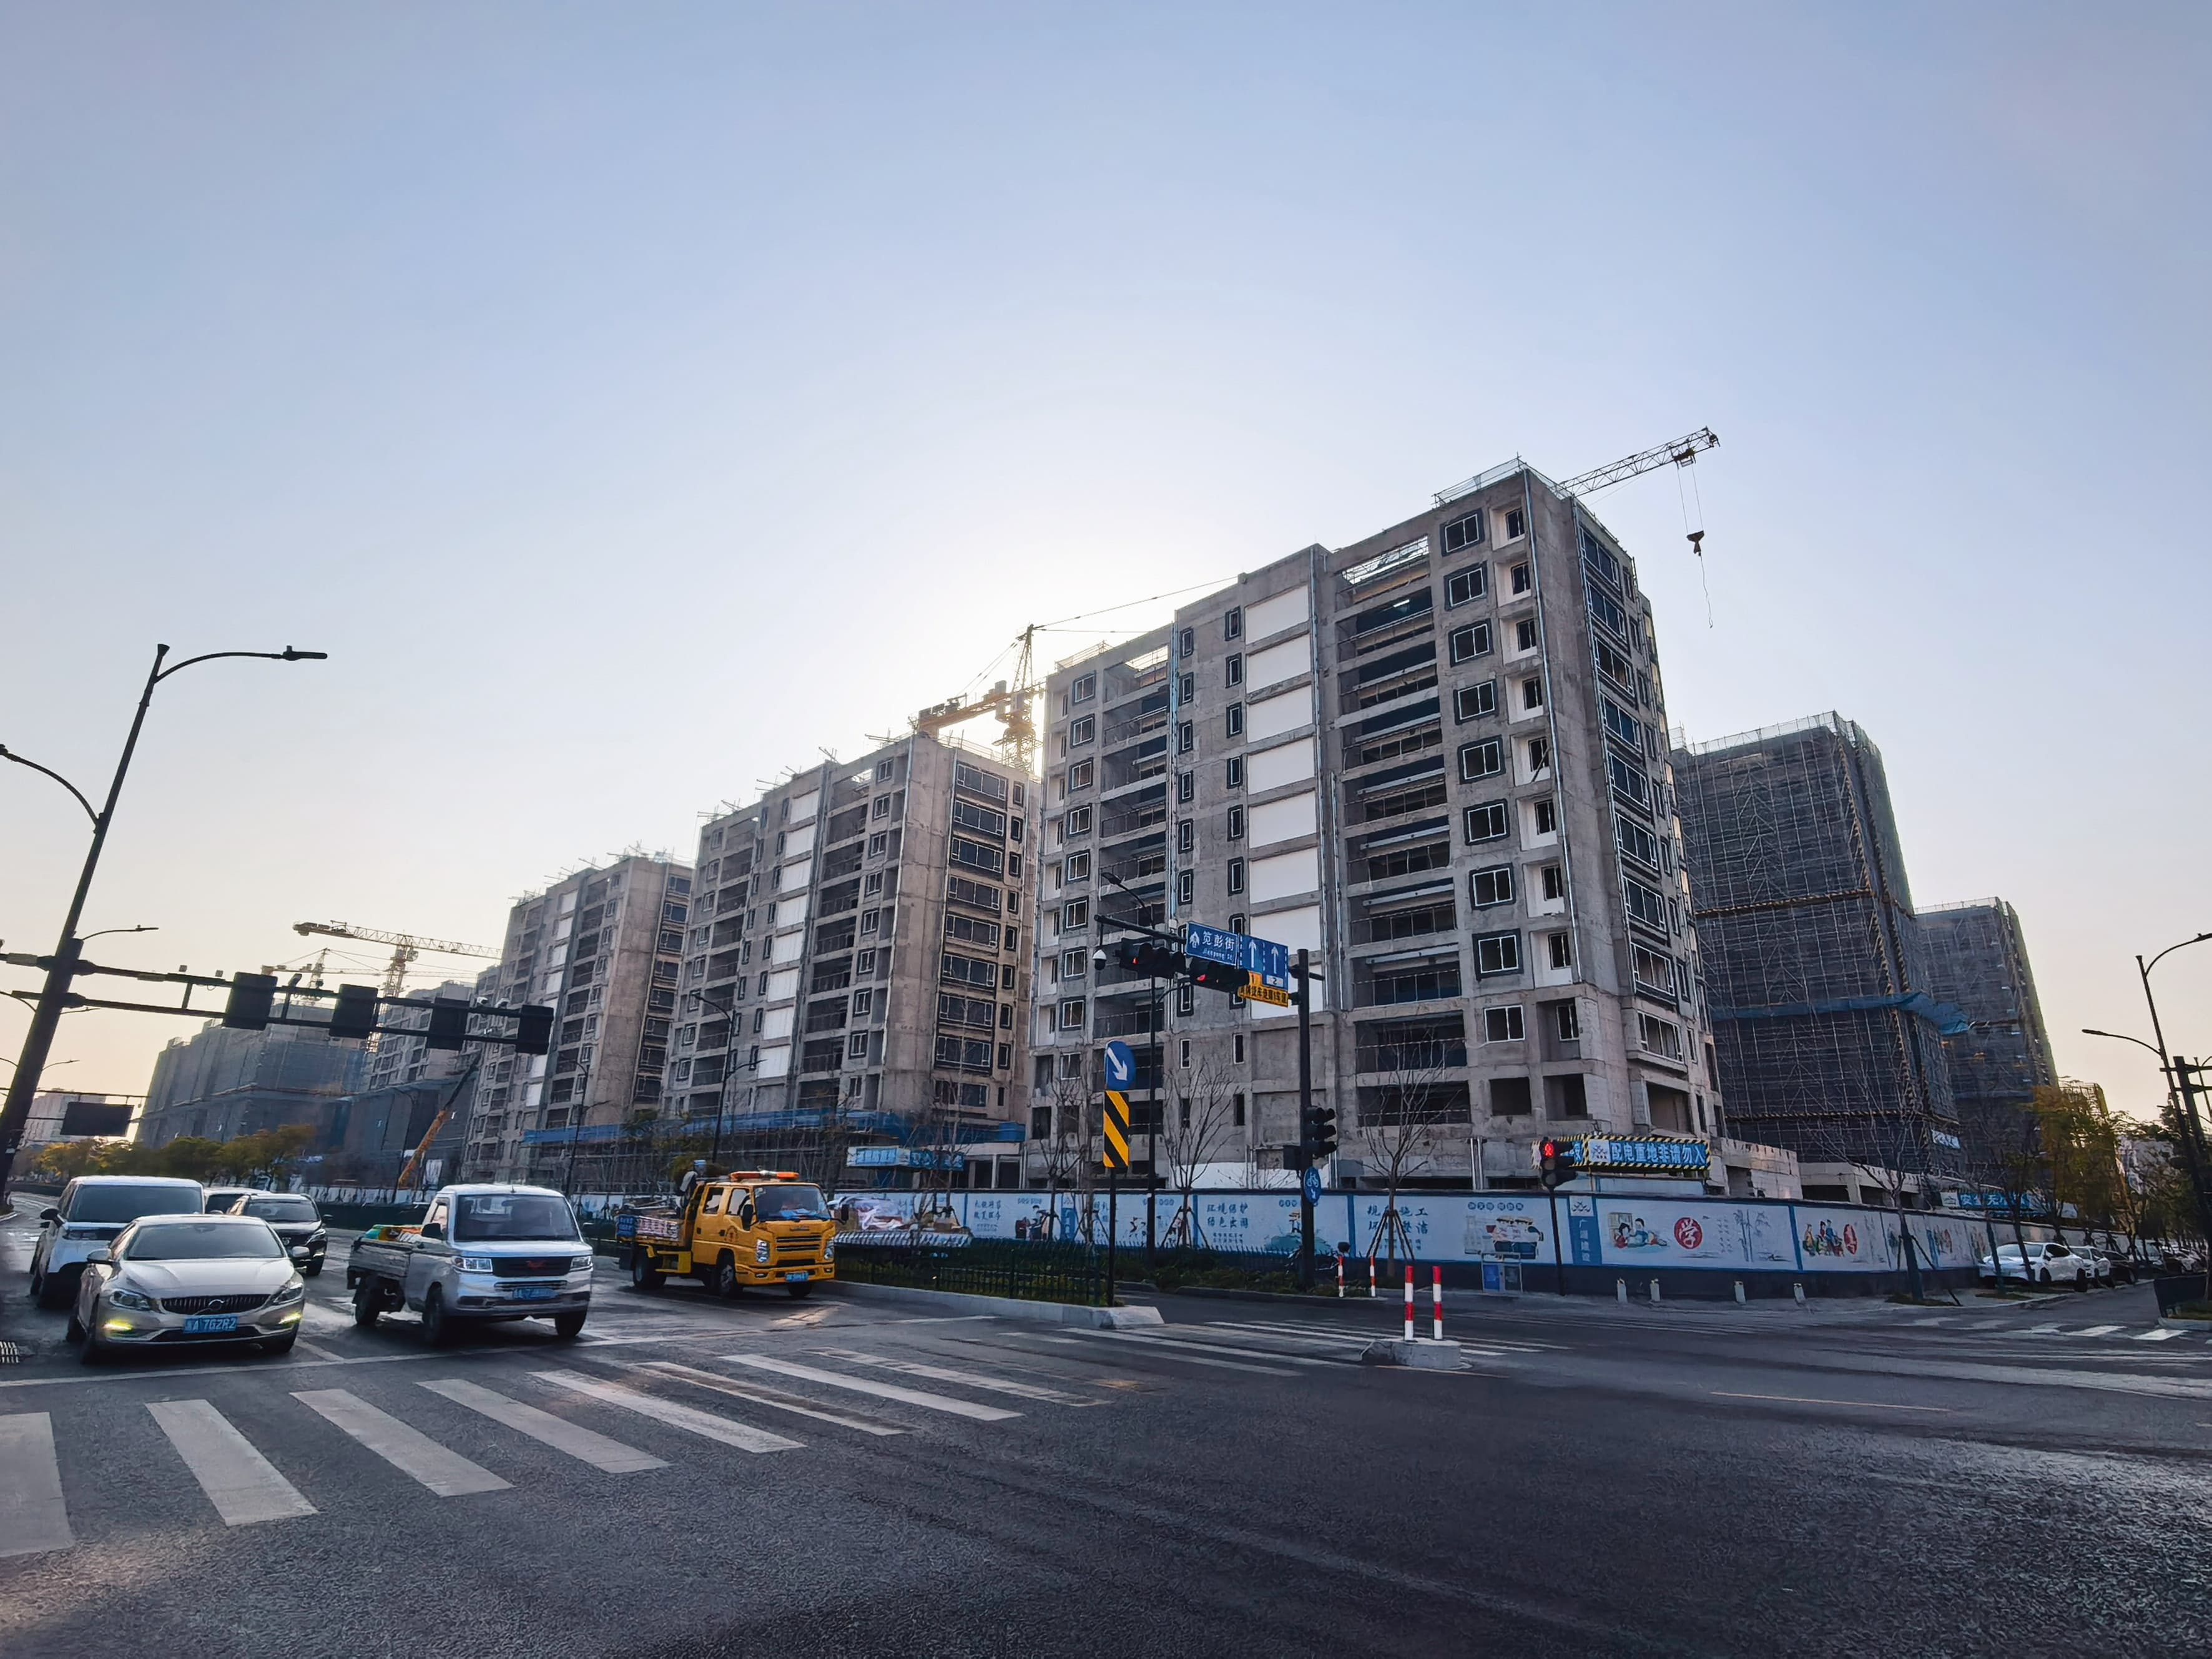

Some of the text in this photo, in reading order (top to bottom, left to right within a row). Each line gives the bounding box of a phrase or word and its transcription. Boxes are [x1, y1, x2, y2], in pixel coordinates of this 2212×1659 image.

[1202, 930, 1235, 951] 笕彭街
[1610, 1141, 1706, 1165] 配电重地非请勿入
[1367, 1205, 1428, 1216] 规施工
[1678, 1218, 1699, 1248] 学
